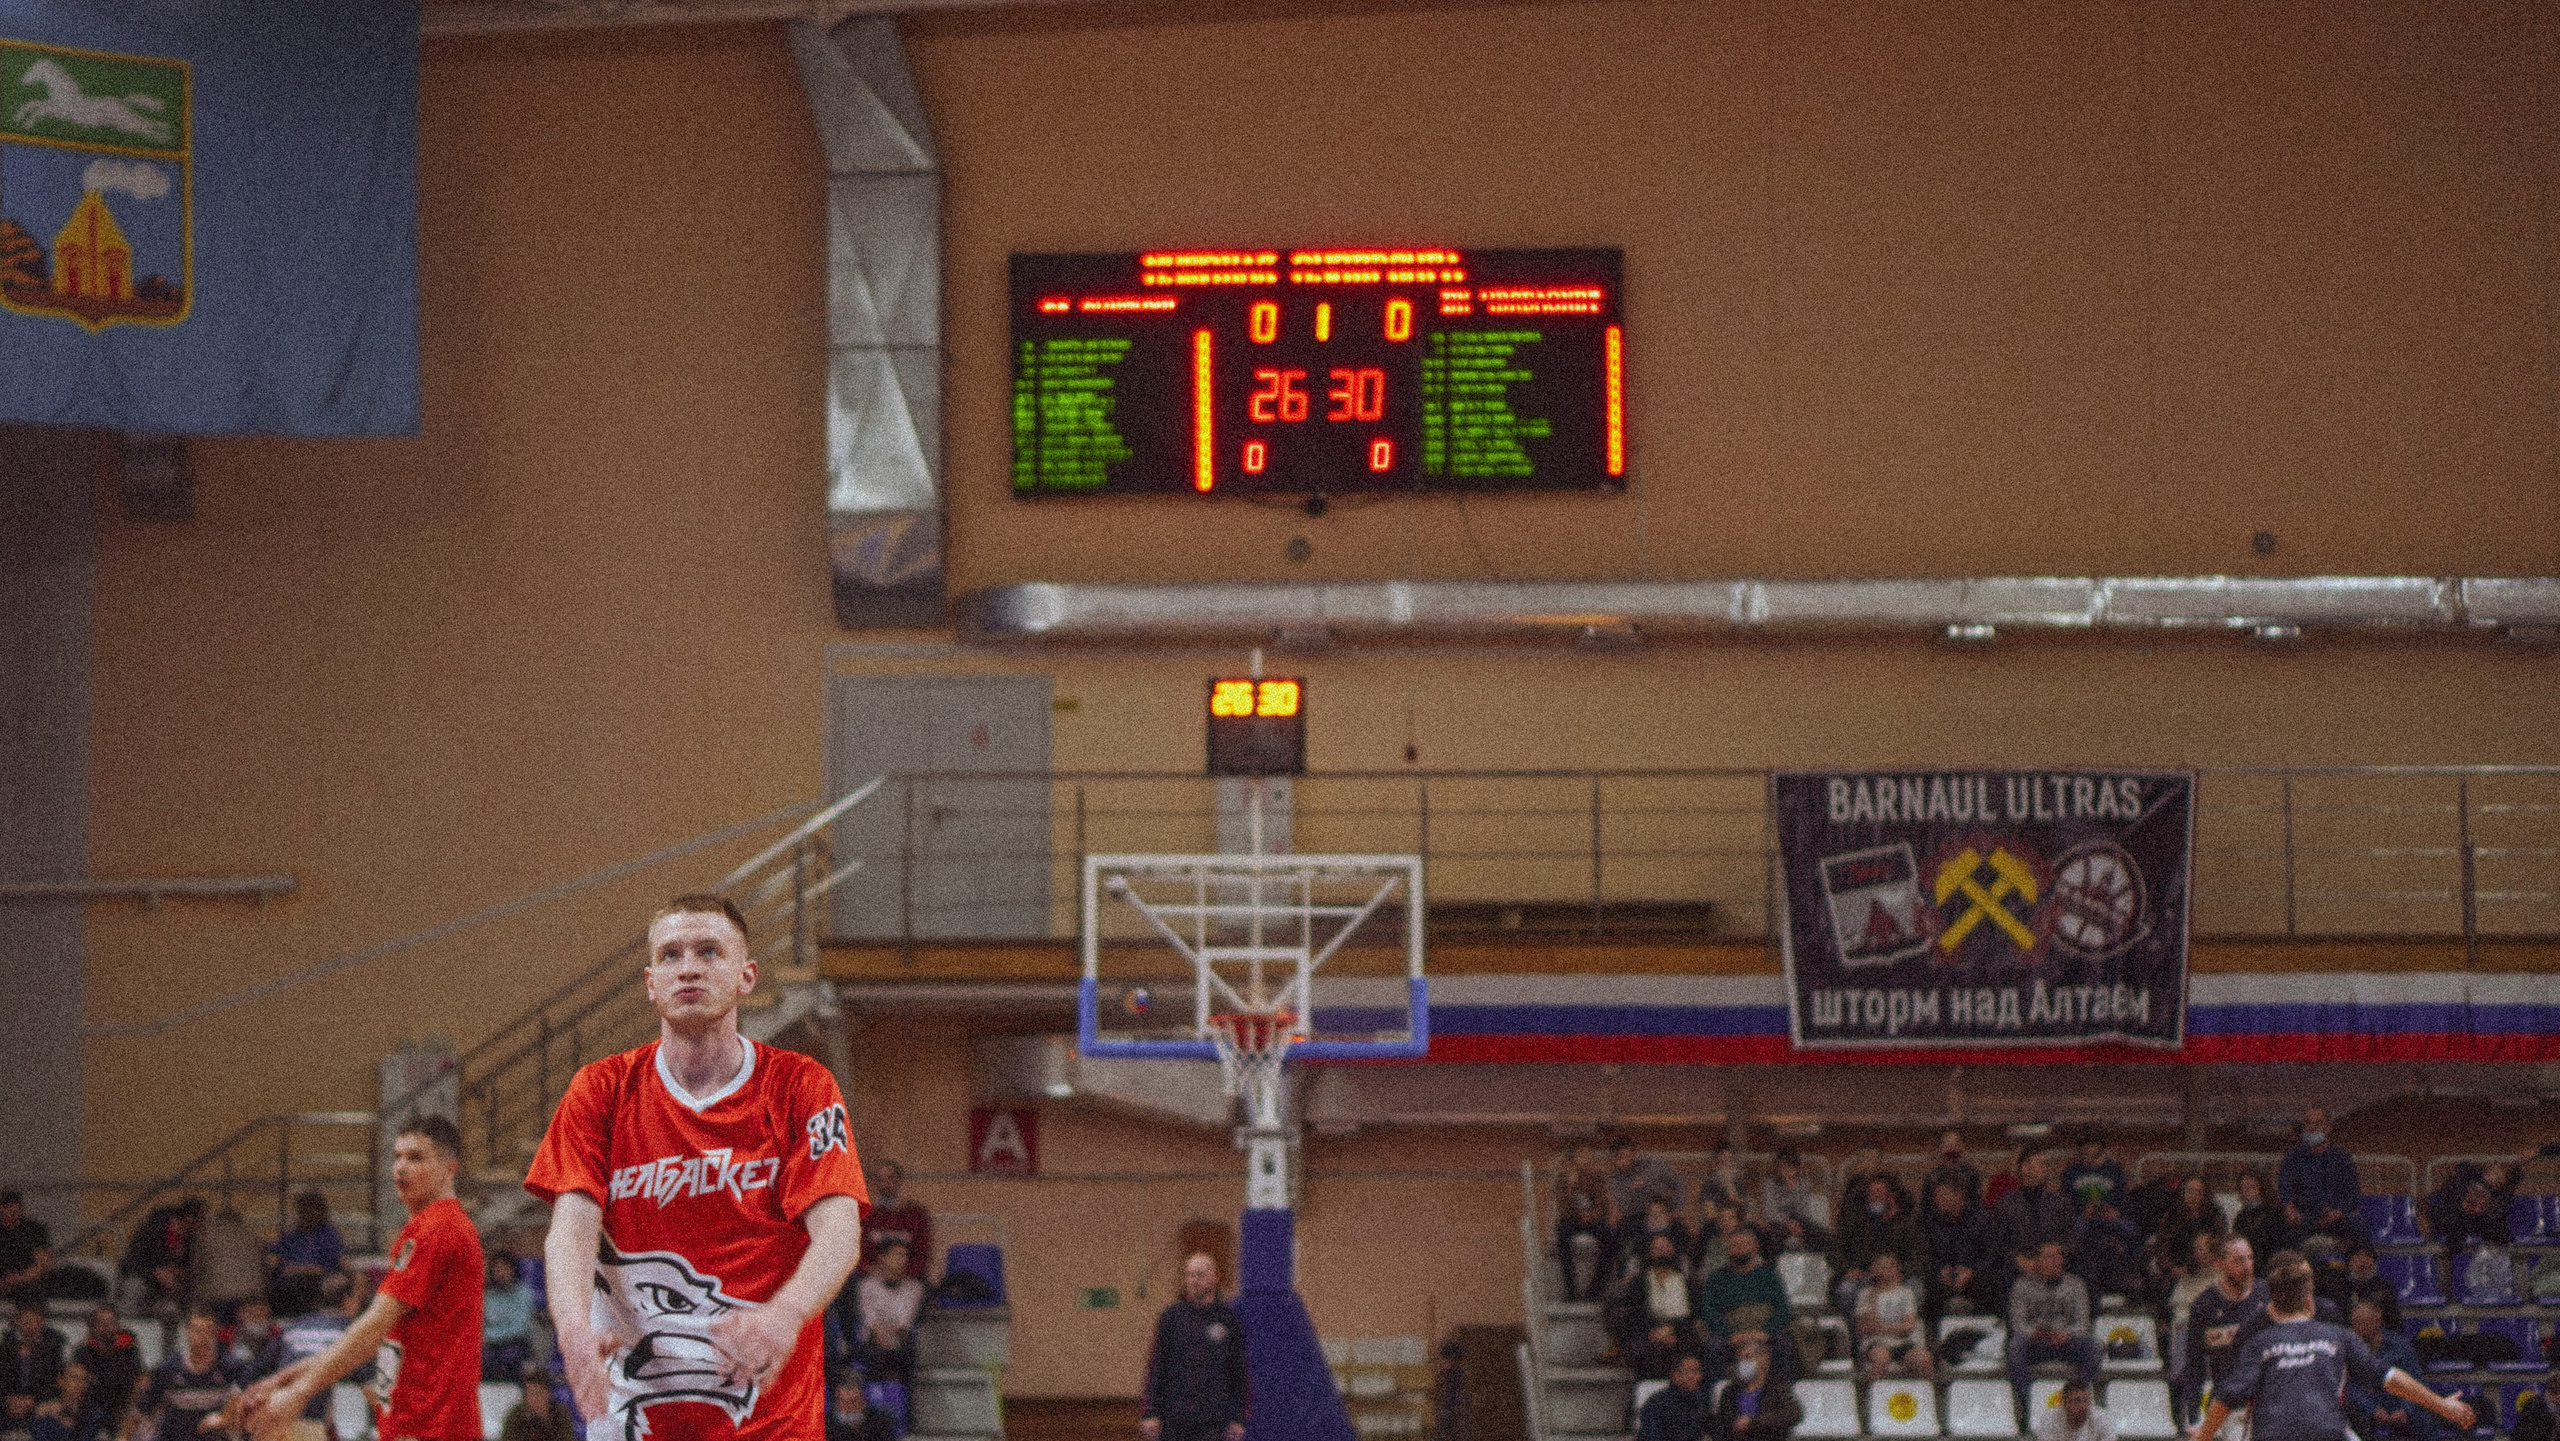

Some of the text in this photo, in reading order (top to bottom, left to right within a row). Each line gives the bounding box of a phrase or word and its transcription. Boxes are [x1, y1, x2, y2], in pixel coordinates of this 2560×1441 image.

[1250, 301, 1278, 344] 0
[1315, 302, 1331, 343] 1
[1384, 299, 1412, 342] 0
[1249, 367, 1386, 423] 26 30
[1243, 441, 1266, 475] 0
[1369, 438, 1393, 472] 0
[1256, 680, 1301, 718] 30
[1828, 776, 2143, 823] BARNAUL ULTRAS
[1811, 977, 2151, 1034] шторм над Алтаем
[979, 1113, 1030, 1162] A
